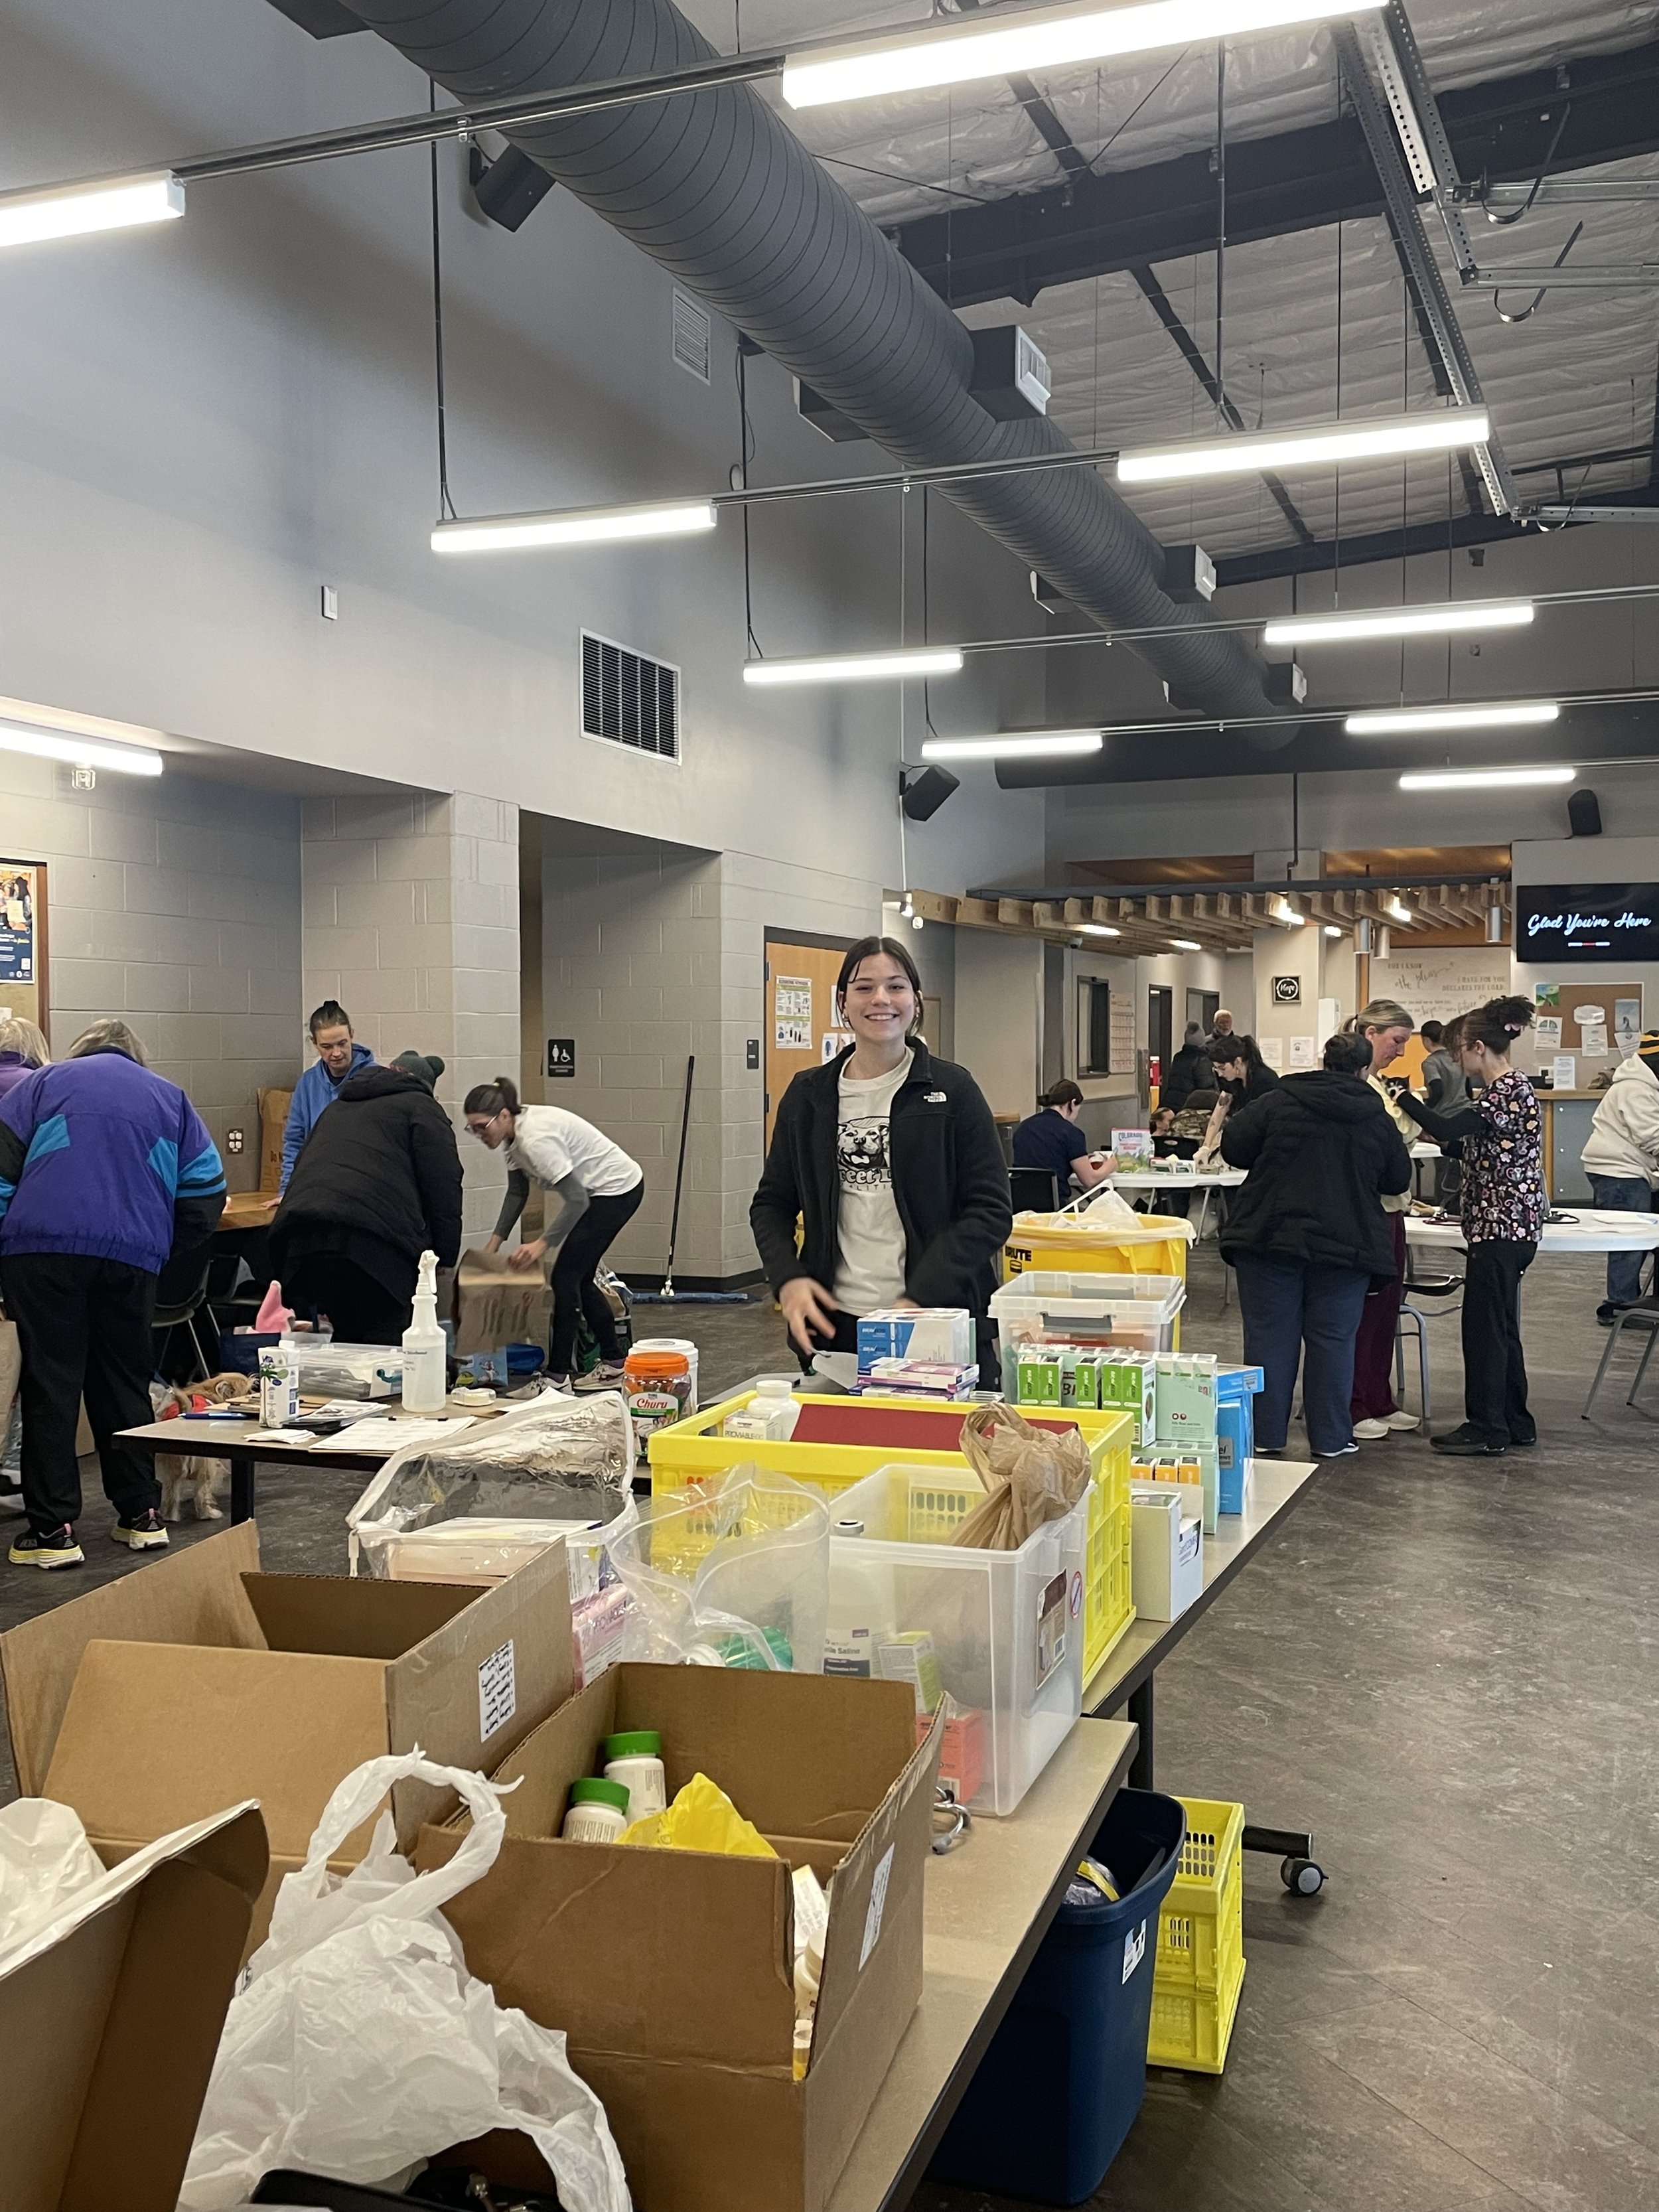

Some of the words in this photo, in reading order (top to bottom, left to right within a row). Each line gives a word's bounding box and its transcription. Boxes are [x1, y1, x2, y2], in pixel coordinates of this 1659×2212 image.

[1528, 914, 1563, 936] Glad
[1563, 913, 1610, 936] You're
[1614, 912, 1652, 928] Here
[838, 1169, 877, 1184] reet
[1005, 1244, 1032, 1262] BRUTE
[637, 1398, 668, 1408] Churu
